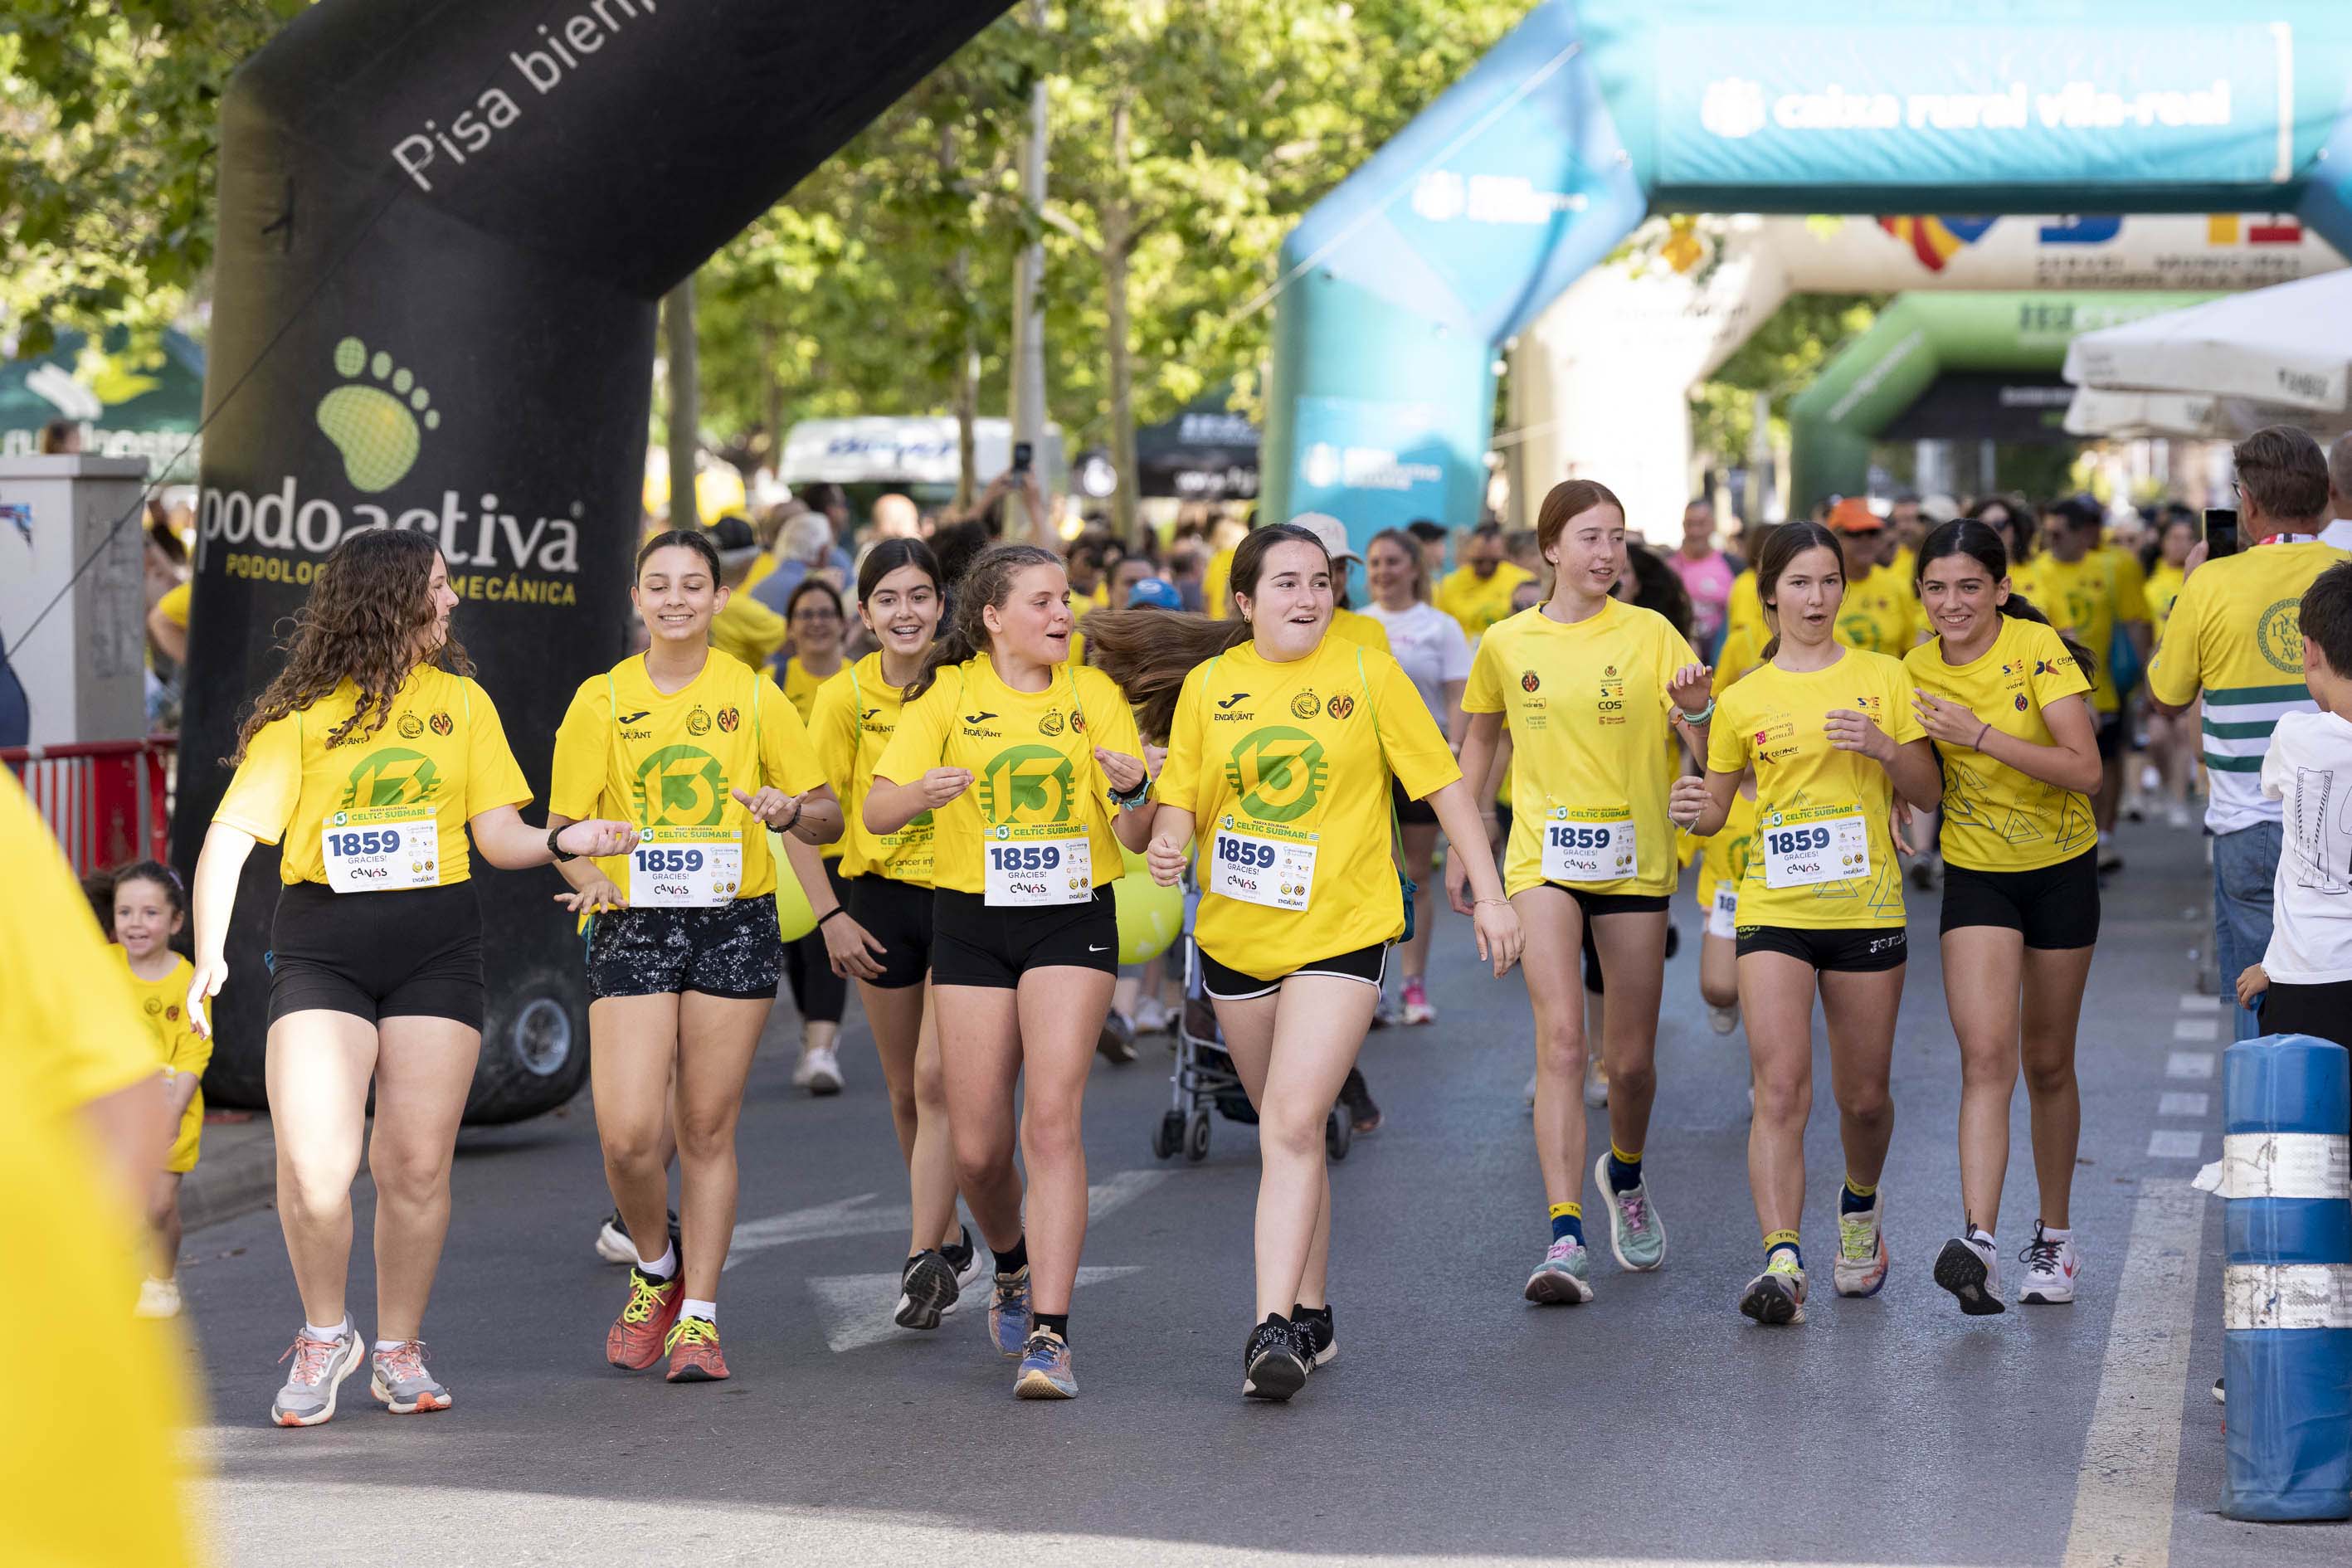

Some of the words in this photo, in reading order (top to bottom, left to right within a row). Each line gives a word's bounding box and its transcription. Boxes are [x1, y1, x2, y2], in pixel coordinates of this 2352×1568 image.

[1773, 83, 1901, 128] caixa
[1906, 81, 2028, 128] rural
[392, 87, 522, 192] Pisa
[225, 553, 329, 586] PODOLOG
[450, 572, 577, 606] MECÁNICA
[352, 812, 382, 821] CELTIC
[385, 806, 426, 818] SUBMARÍ
[1600, 809, 1630, 818] SUBMAR
[1785, 811, 1813, 821] CELTIC
[1814, 804, 1853, 816] SUBMARÍ
[690, 830, 730, 838] SUBMARÍ
[1014, 828, 1045, 836] CELTIC
[1047, 824, 1081, 835] SUBMARÍ
[1236, 821, 1264, 833] CELTIC
[1266, 826, 1307, 840] SUBMARÍ
[1550, 826, 1610, 849] 1859
[1768, 827, 1830, 855] 1859
[328, 830, 401, 857] 1859
[1218, 836, 1276, 869] 1859
[635, 850, 704, 872] 1859
[991, 846, 1060, 871] 1859
[1718, 895, 1736, 913] 18
